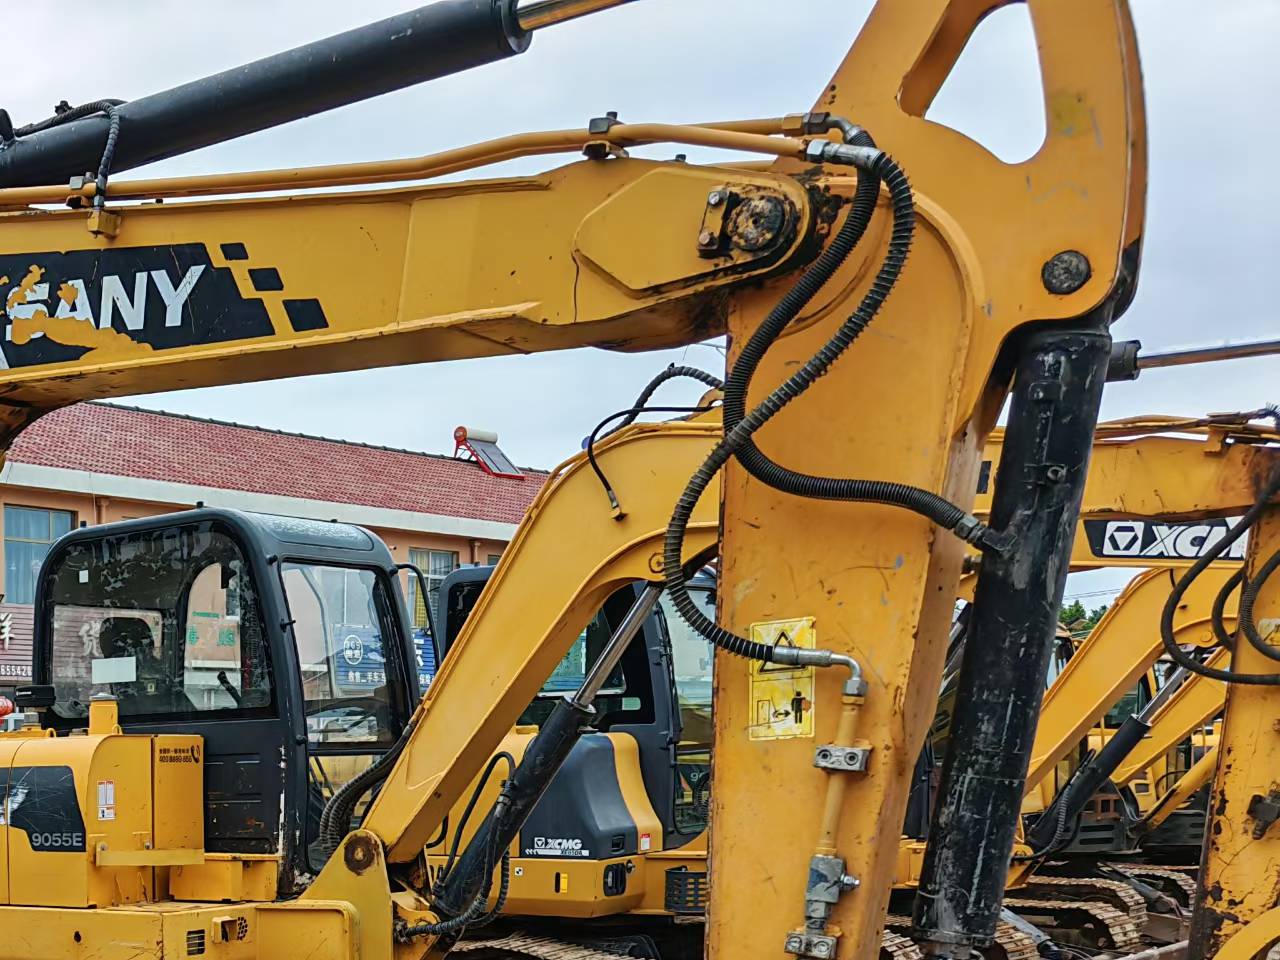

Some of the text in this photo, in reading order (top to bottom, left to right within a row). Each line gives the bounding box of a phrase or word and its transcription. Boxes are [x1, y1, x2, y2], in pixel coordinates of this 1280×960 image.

[1140, 524, 1248, 558] XCM
[31, 832, 83, 847] 9055E
[546, 838, 583, 849] XCMG
